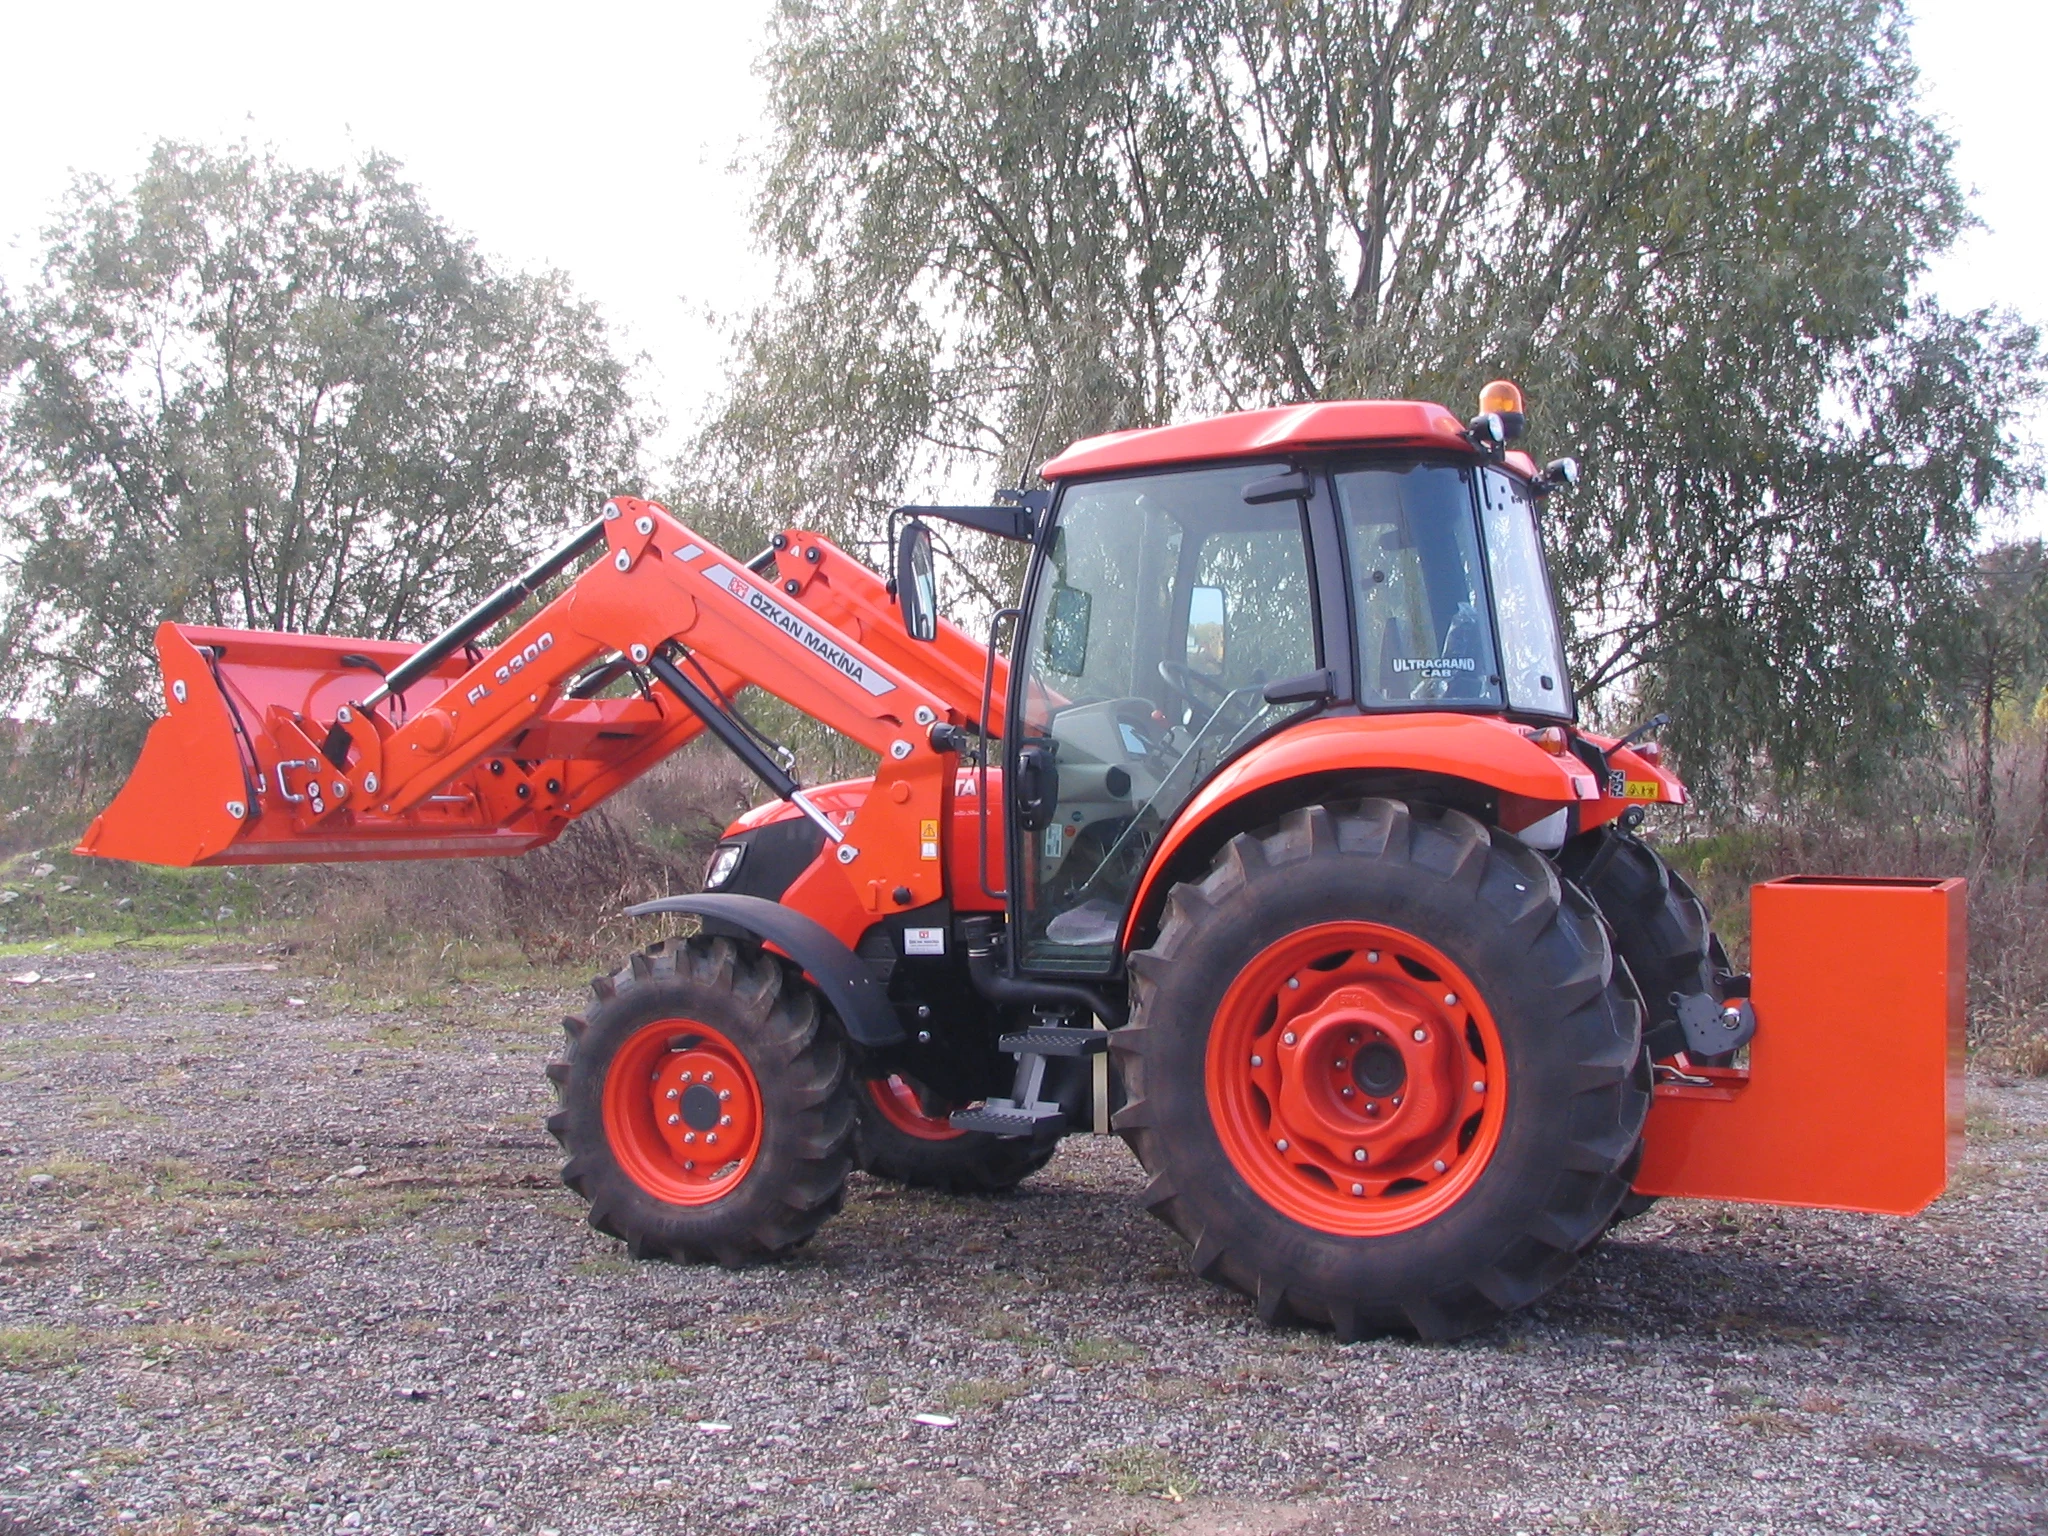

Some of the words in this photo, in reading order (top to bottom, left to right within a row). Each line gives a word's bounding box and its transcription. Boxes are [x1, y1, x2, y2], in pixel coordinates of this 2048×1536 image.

[750, 593, 804, 638] ÖZKAN
[467, 683, 493, 706] FL
[494, 632, 555, 685] 3300
[1393, 657, 1475, 673] ULTRAGRAND
[1421, 669, 1452, 678] CAB
